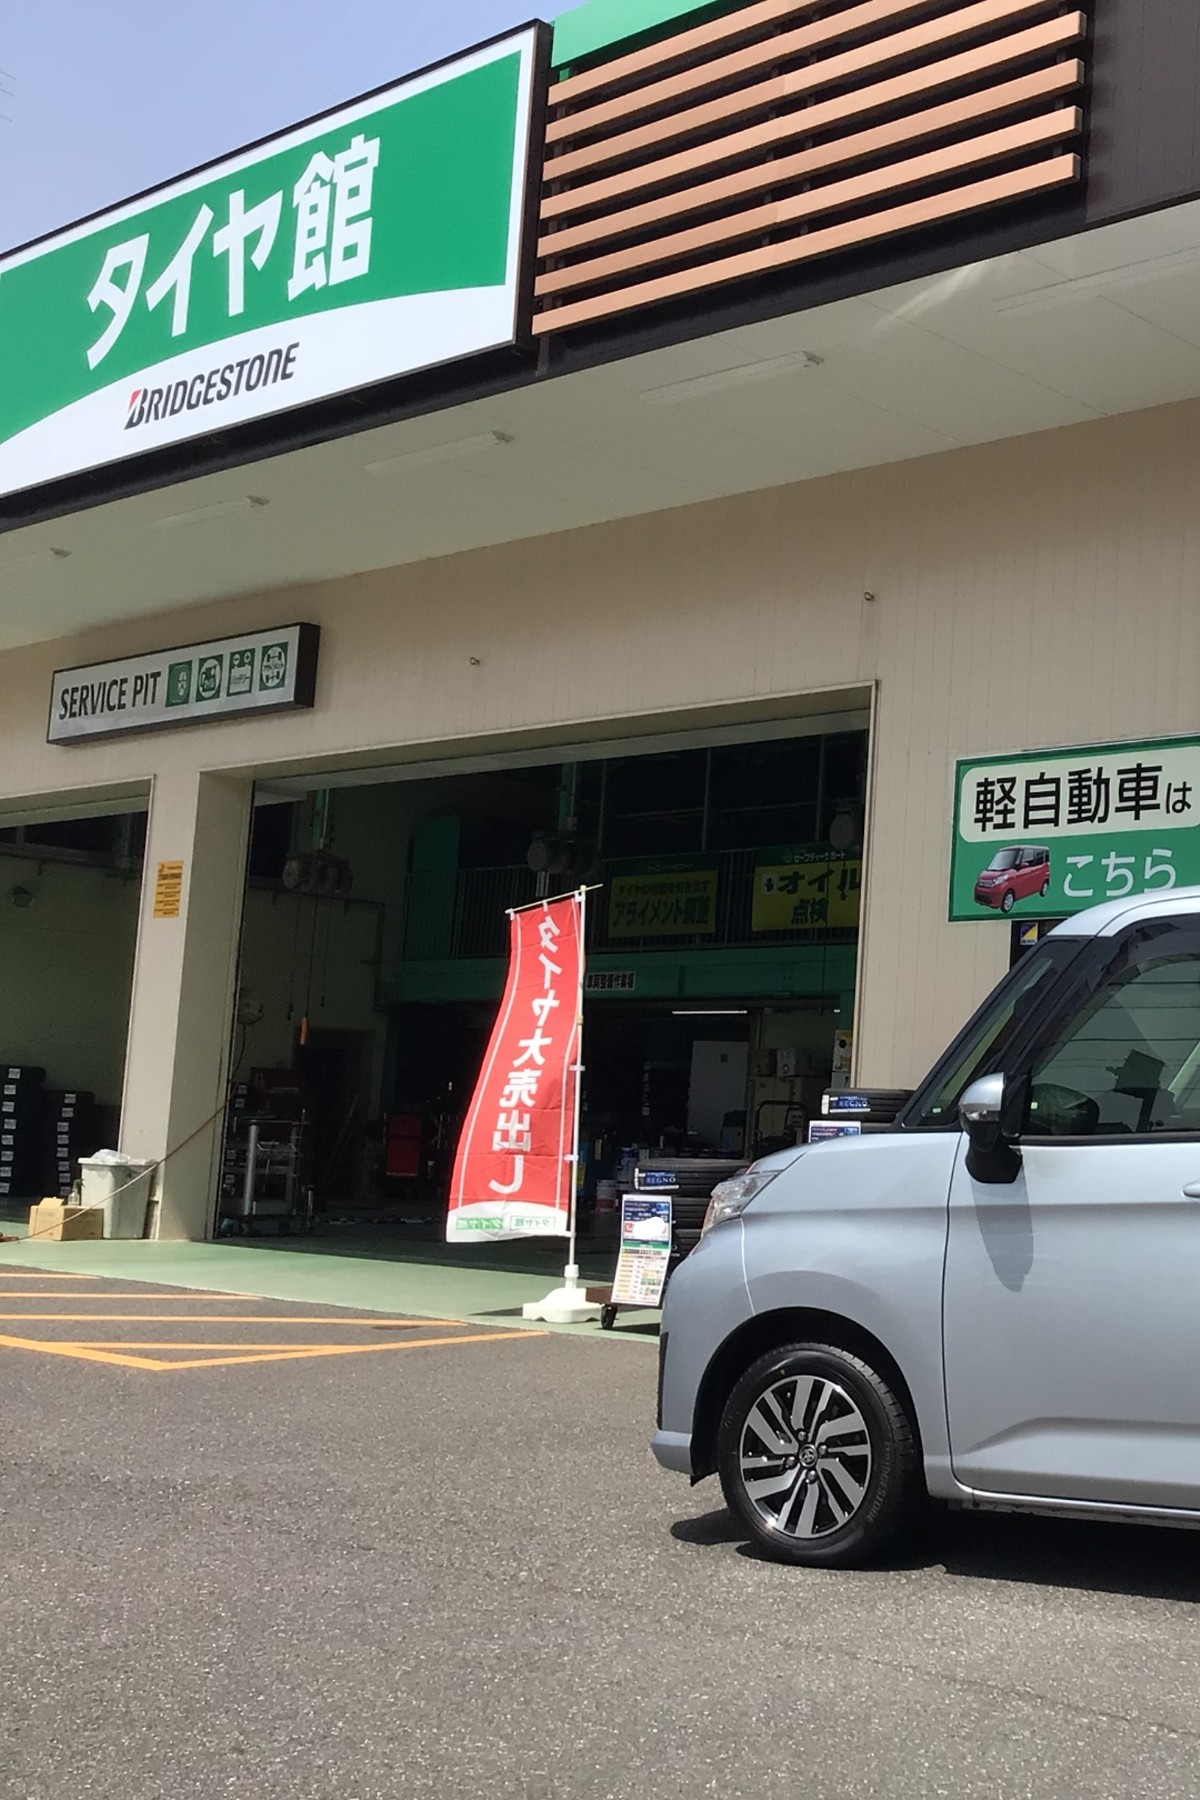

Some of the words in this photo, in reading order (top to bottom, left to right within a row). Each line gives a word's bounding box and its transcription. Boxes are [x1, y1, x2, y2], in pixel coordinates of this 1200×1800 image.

[87, 133, 380, 370] タイヤ館
[124, 342, 300, 430] BRIDGESTONE
[58, 677, 129, 720] SERVICE
[131, 670, 162, 707] PIT
[974, 762, 1192, 833] 軽自動車は
[1063, 847, 1177, 898] こちら
[791, 897, 829, 924] 点検
